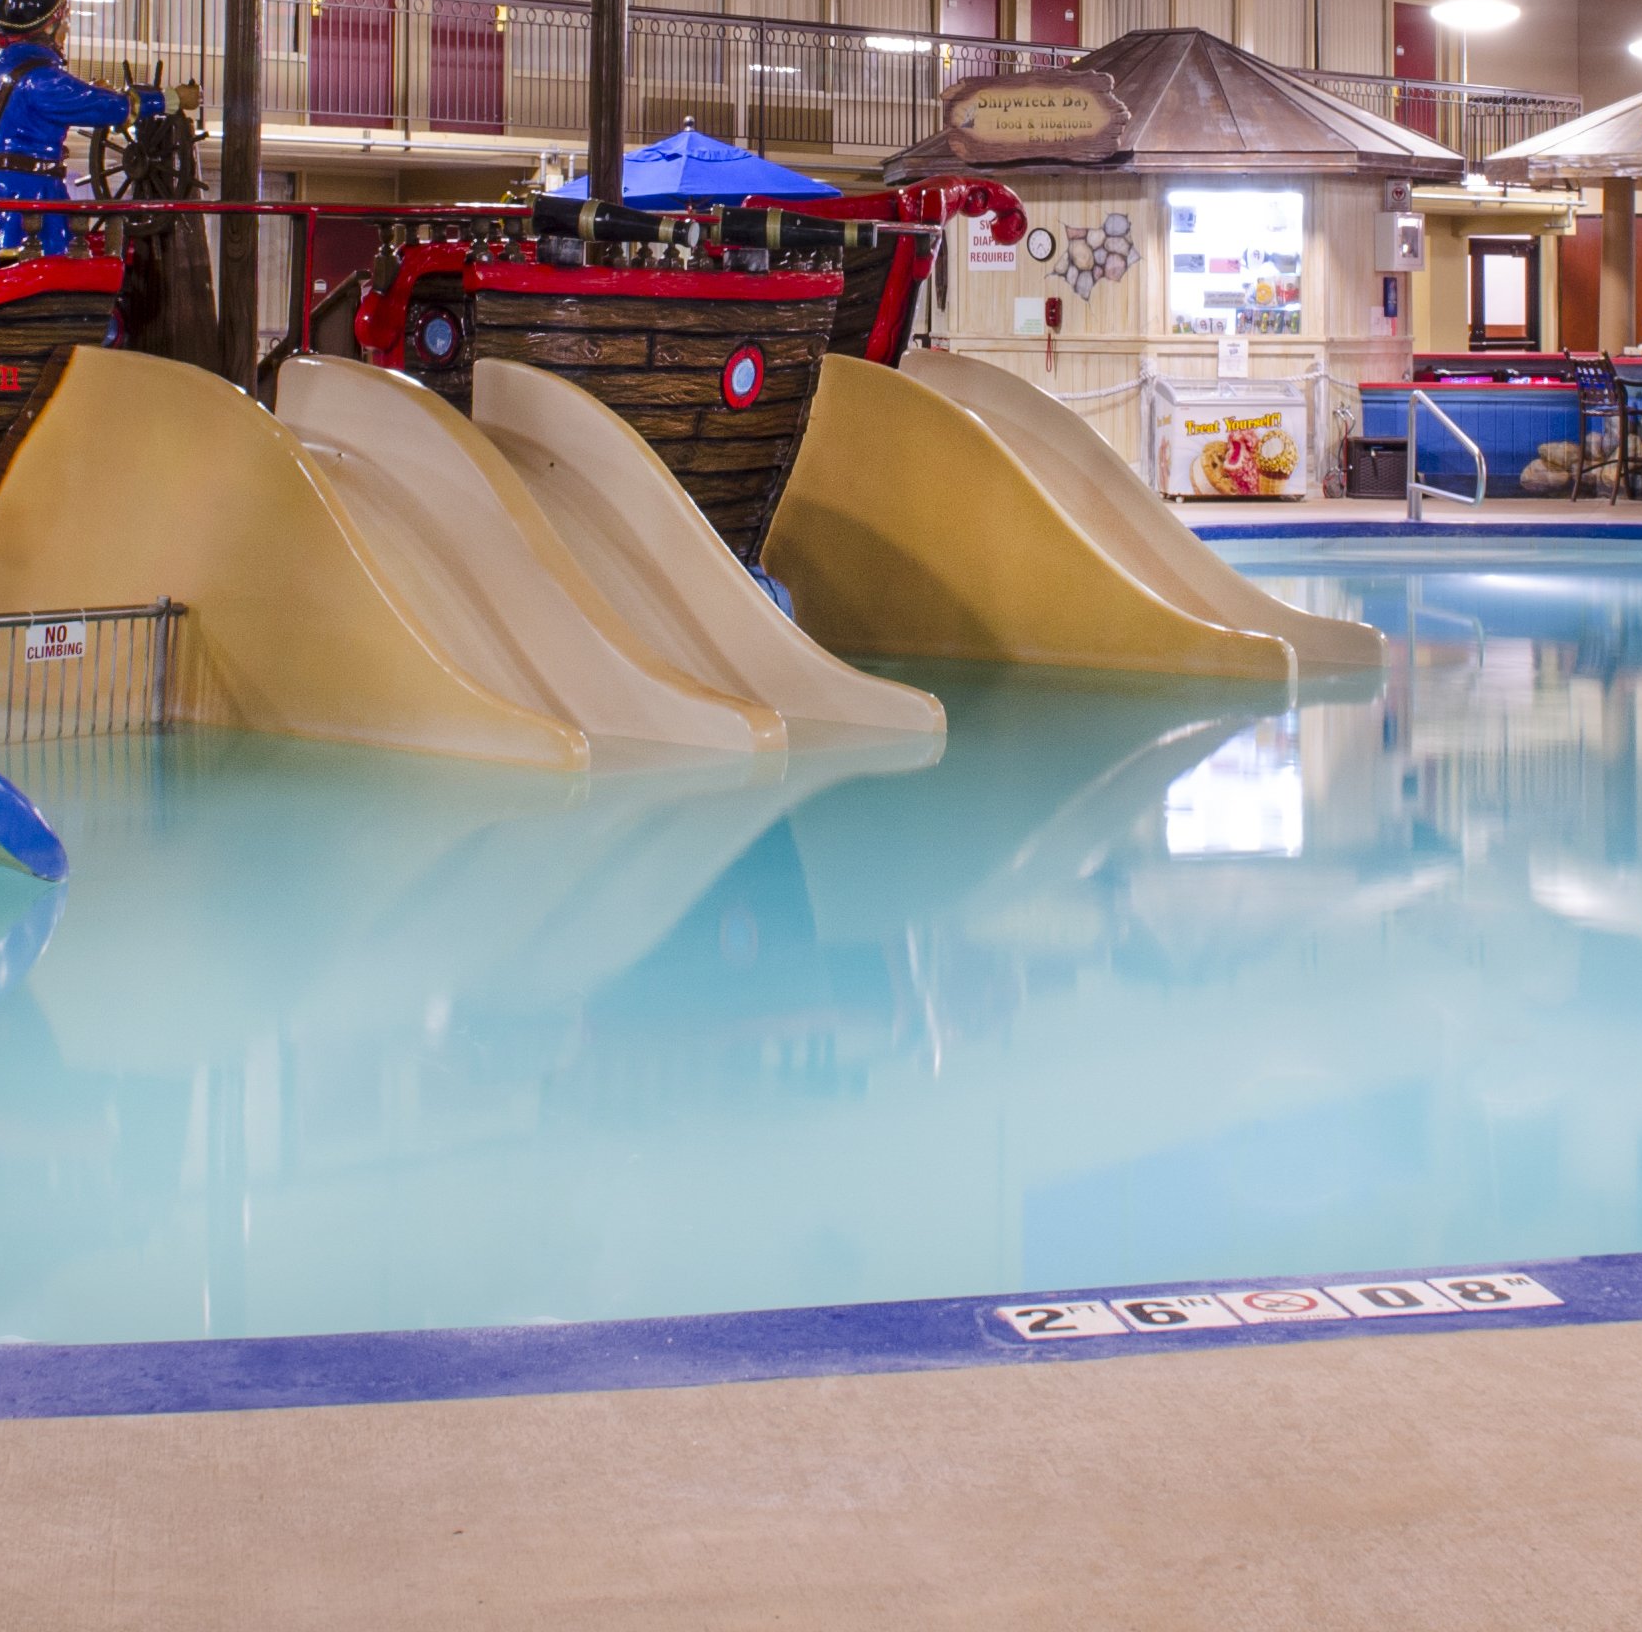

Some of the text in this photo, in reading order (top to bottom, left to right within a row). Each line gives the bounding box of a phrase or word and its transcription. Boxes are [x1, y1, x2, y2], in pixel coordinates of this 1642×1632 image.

[978, 91, 1090, 112] Shipwreck Bay
[996, 118, 1093, 130] food & libations
[970, 252, 1014, 263] REQUIRED
[1185, 420, 1220, 436] Treat
[1223, 412, 1282, 433] Yourself!
[45, 624, 68, 644] NO
[27, 642, 83, 660] CLIMBING
